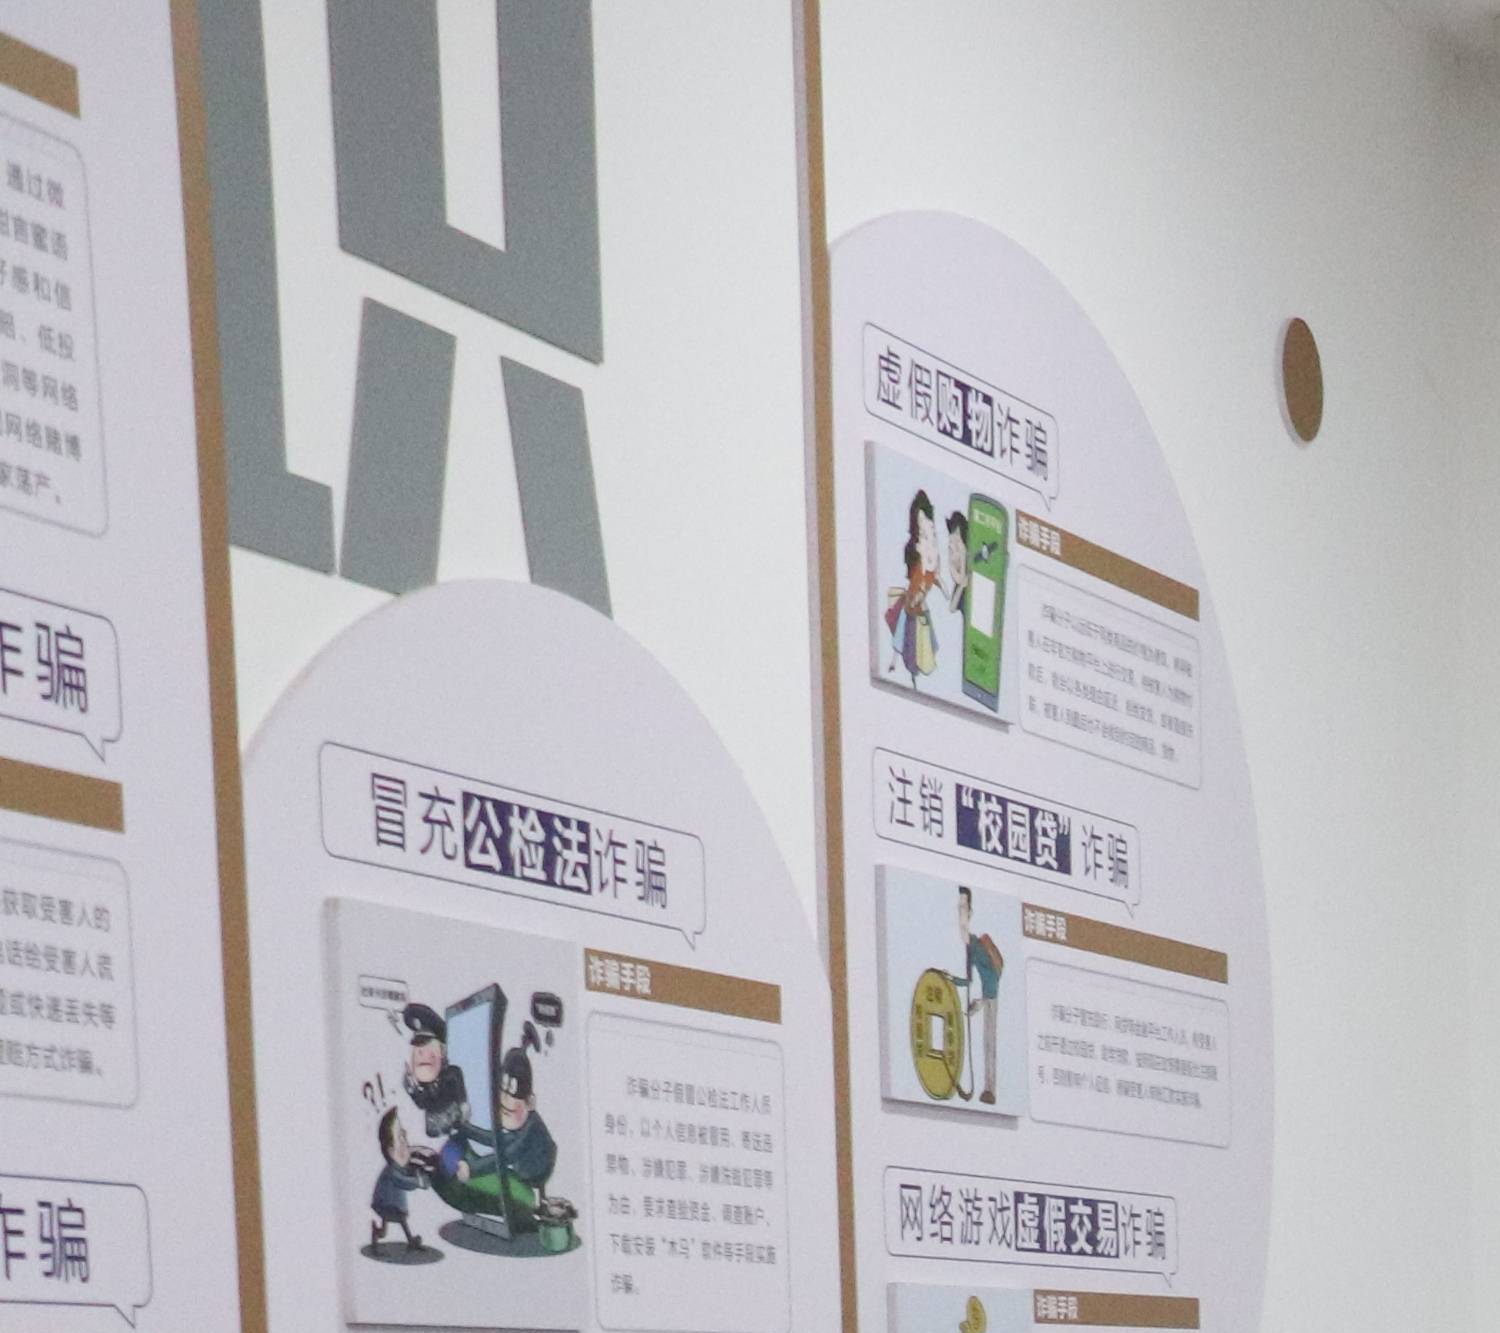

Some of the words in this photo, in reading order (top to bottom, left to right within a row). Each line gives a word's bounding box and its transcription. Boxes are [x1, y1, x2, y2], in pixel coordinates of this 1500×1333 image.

[876, 345, 1050, 483] 虚假购物诈骗
[370, 772, 669, 911] 冒充公检法诈骗
[588, 957, 653, 997] 诈骗手段
[899, 1182, 1168, 1262] 网络游戏虚假交易诈骗
